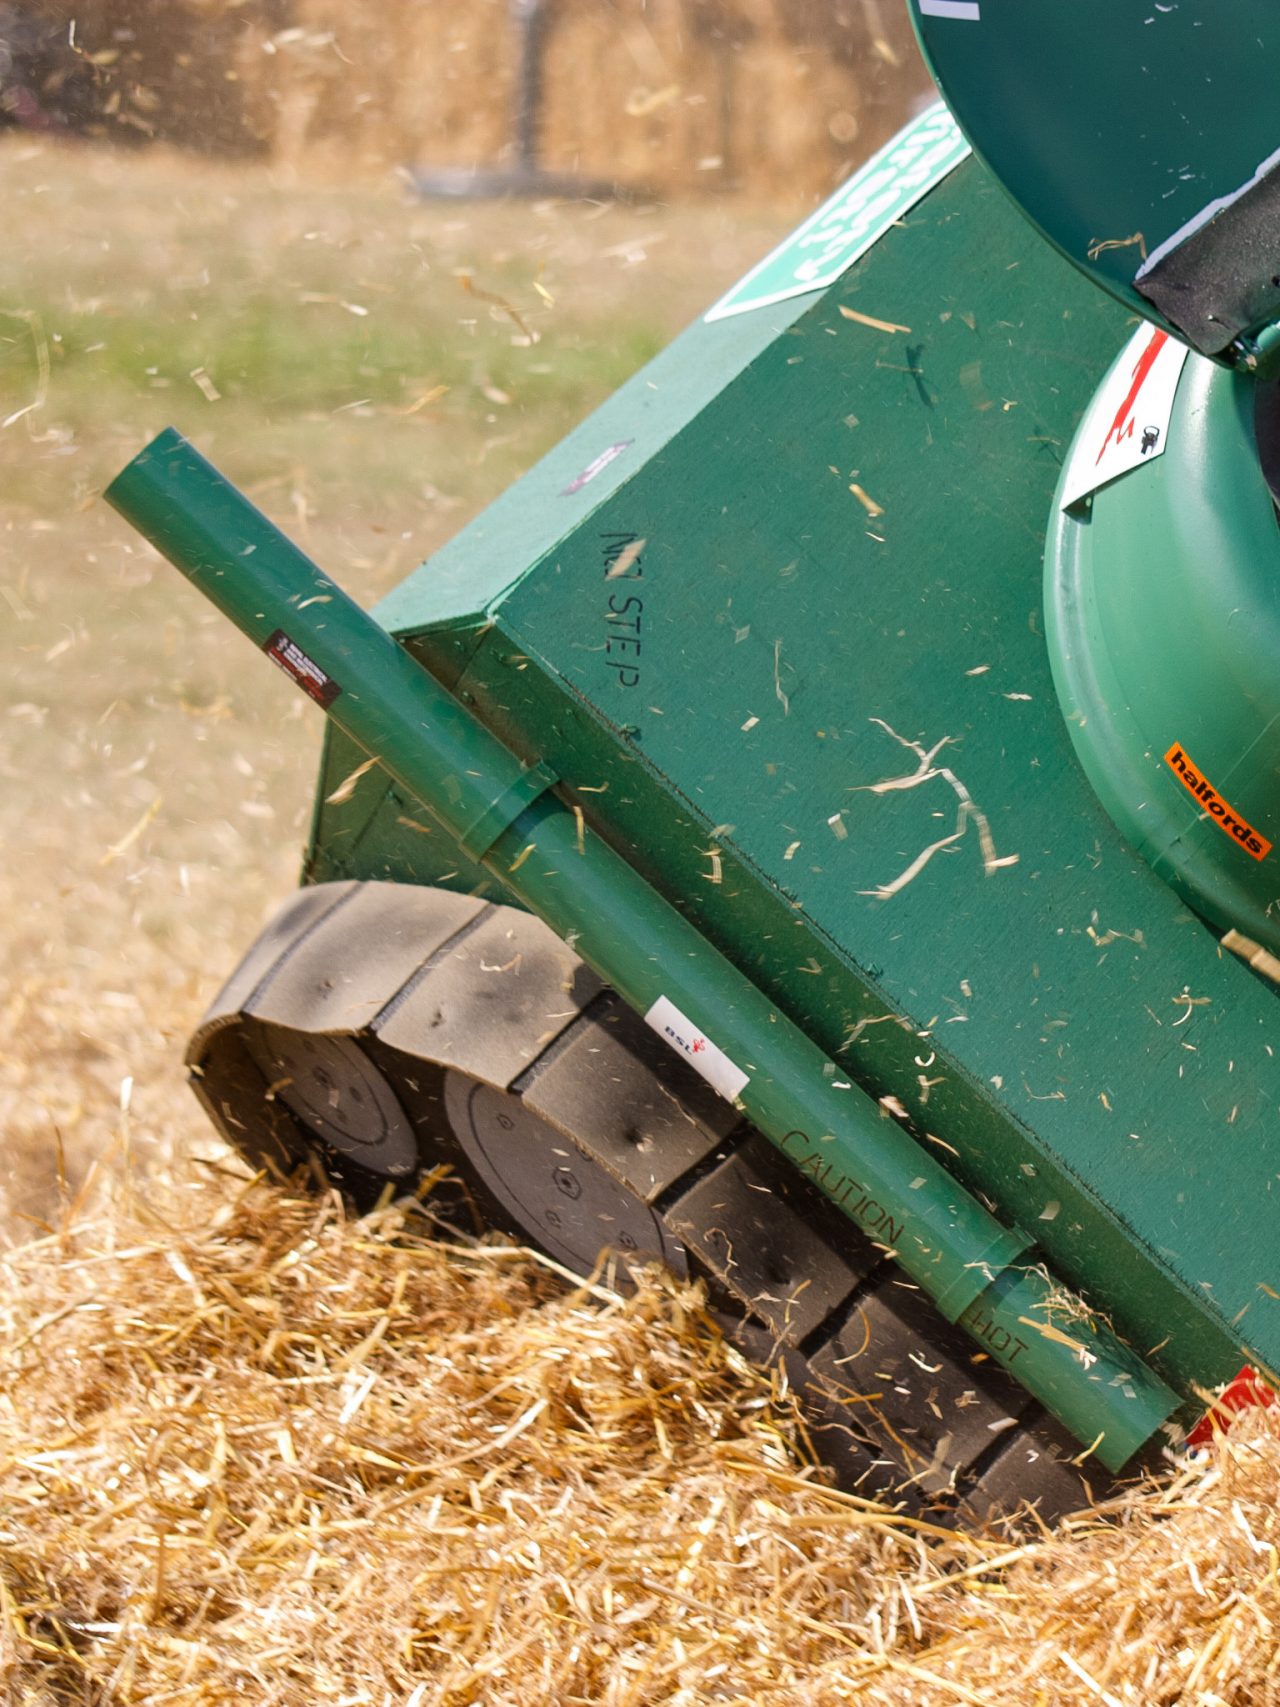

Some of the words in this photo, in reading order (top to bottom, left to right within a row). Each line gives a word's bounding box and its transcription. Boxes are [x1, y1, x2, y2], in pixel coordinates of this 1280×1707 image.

[605, 594, 644, 688] STEP
[1171, 750, 1263, 854] halfords
[779, 1130, 905, 1245] CAUTION
[970, 1310, 1029, 1363] HOT
